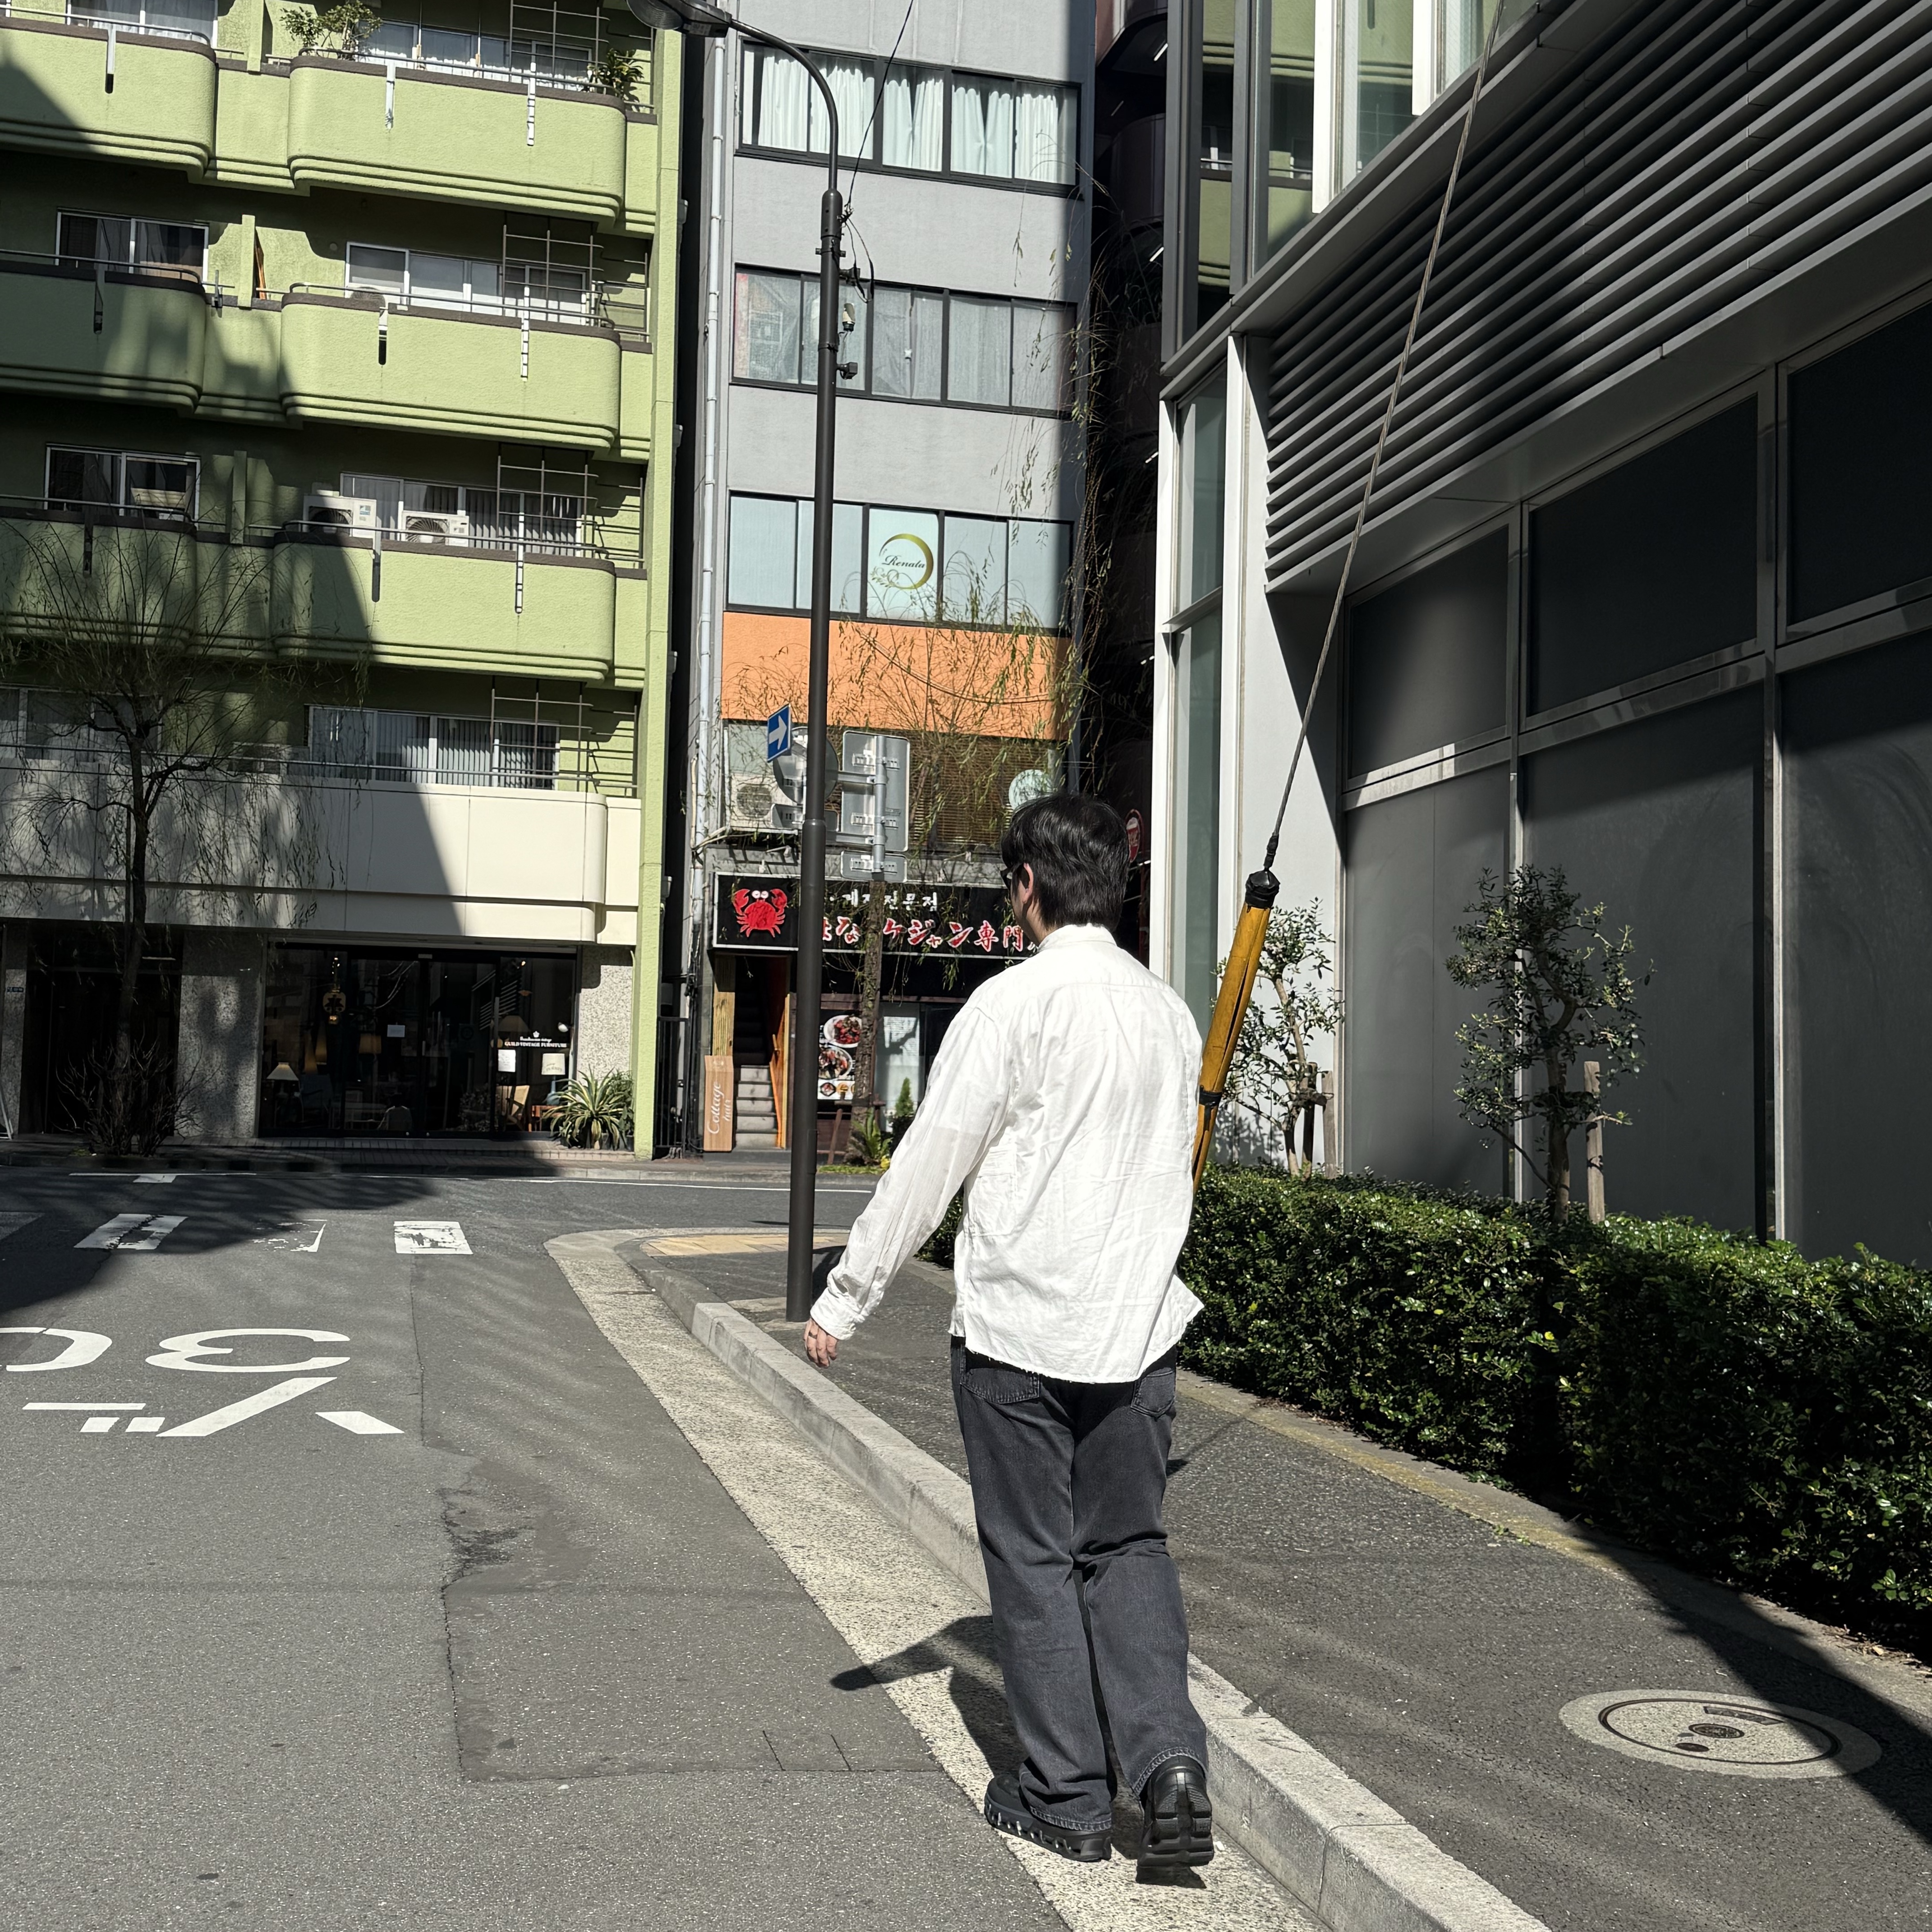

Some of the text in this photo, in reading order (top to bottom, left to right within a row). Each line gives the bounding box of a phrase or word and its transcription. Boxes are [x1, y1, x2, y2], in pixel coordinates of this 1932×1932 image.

[881, 555, 926, 569] Renata
[883, 917, 1039, 953] ケジャン専門
[707, 1081, 725, 1135] Cottage
